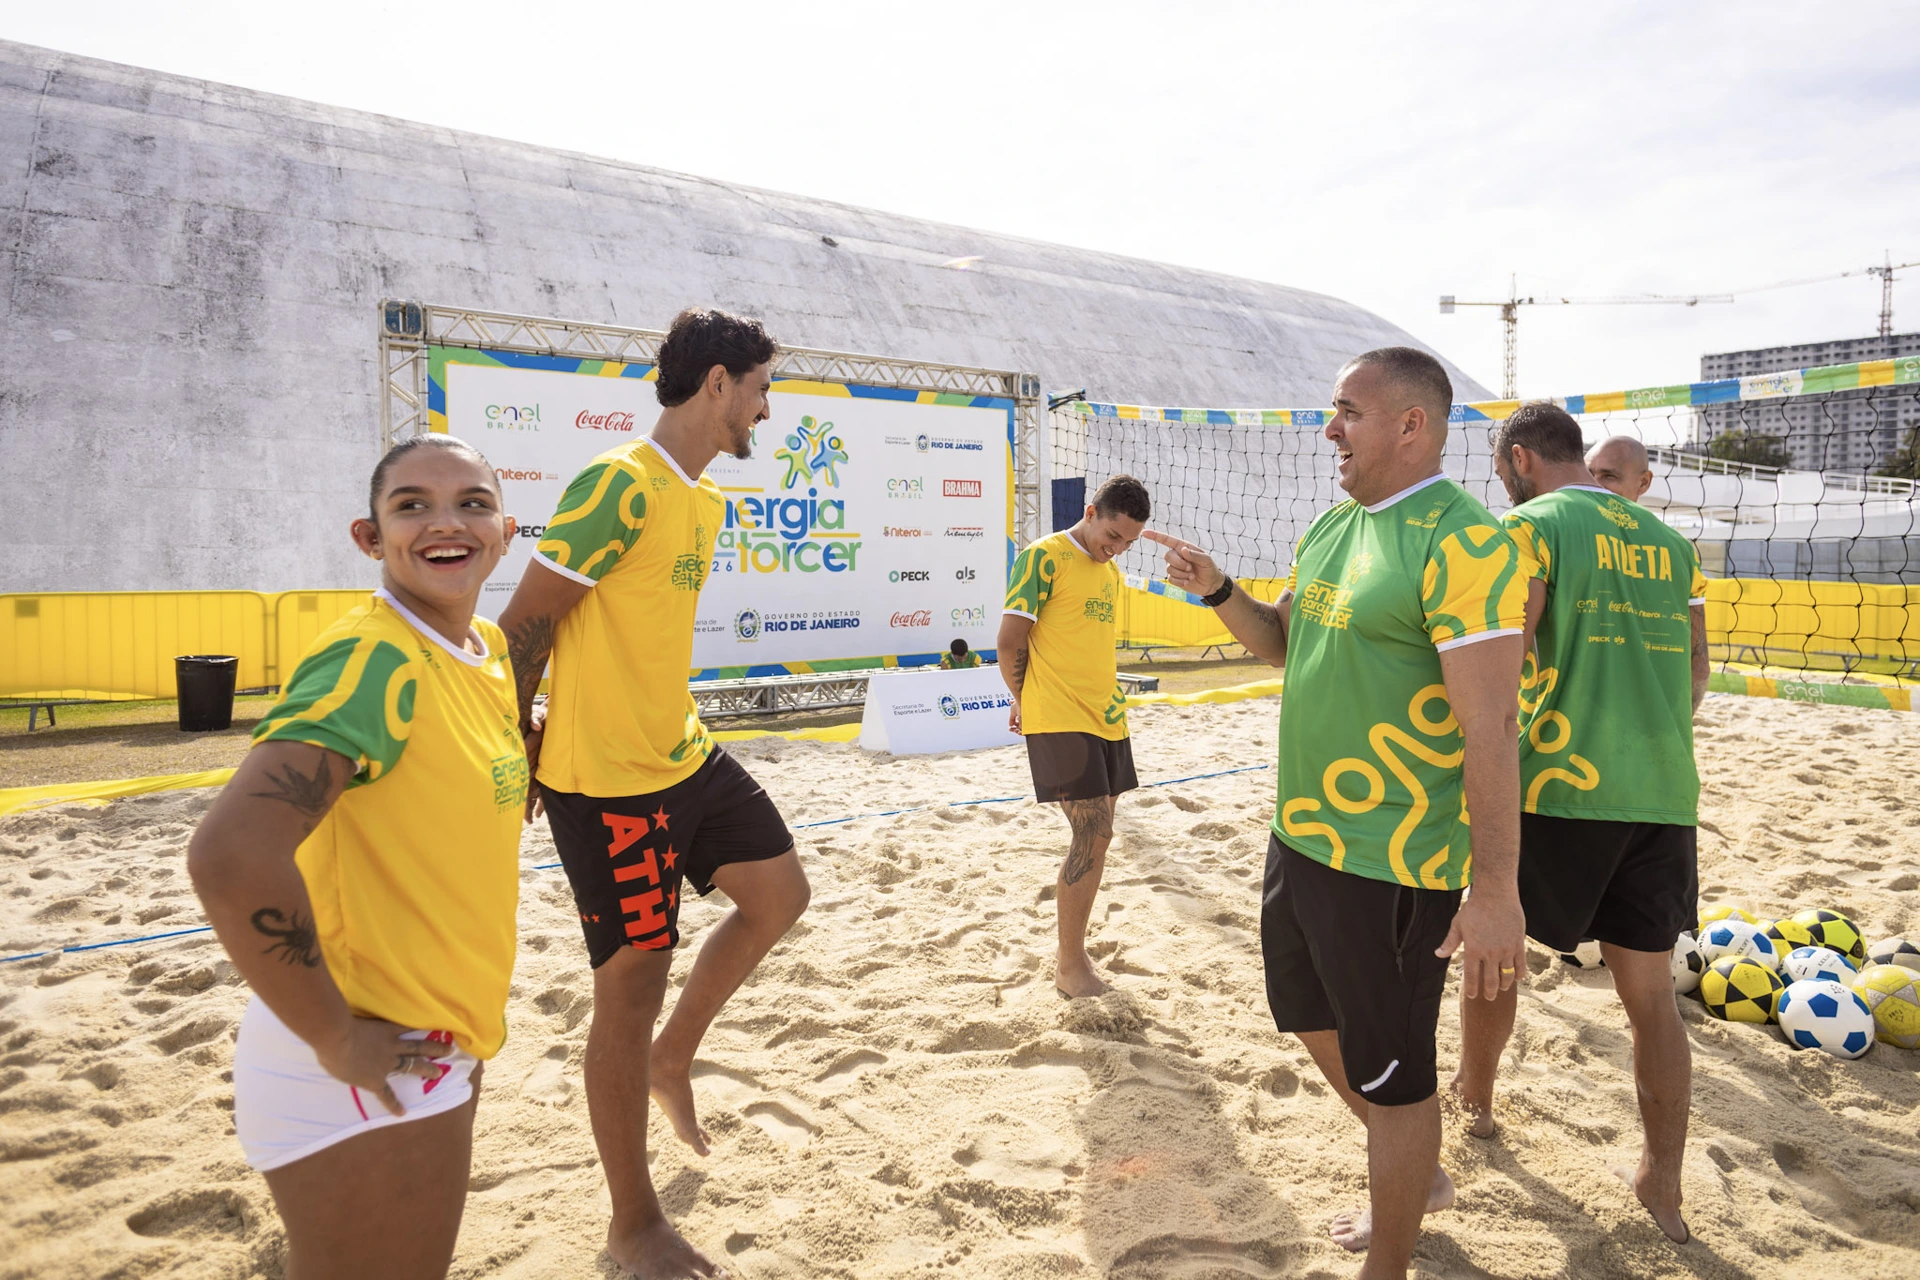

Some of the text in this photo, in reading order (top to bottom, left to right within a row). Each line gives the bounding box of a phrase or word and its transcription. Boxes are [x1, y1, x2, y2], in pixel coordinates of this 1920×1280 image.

[1631, 386, 1666, 402] enel
[485, 403, 541, 422] enel
[487, 421, 540, 431] BRASIL
[575, 409, 636, 432] Coca-Cola
[955, 443, 983, 451] JANEIRO
[887, 476, 923, 491] enel
[944, 480, 980, 496] BRAHMA
[736, 531, 862, 573] torcer
[1595, 533, 1673, 582] ATLETA
[901, 570, 930, 581] PECK
[951, 604, 985, 620] enel
[1299, 598, 1326, 613] para
[764, 612, 808, 620] GOVERNO
[890, 609, 932, 628] Coca-Cola
[764, 618, 860, 632] RIO DE JANEIRO
[960, 694, 993, 702] GOVERNO
[1783, 684, 1826, 698] enel
[961, 702, 980, 711] RIO
[980, 700, 995, 709] DE
